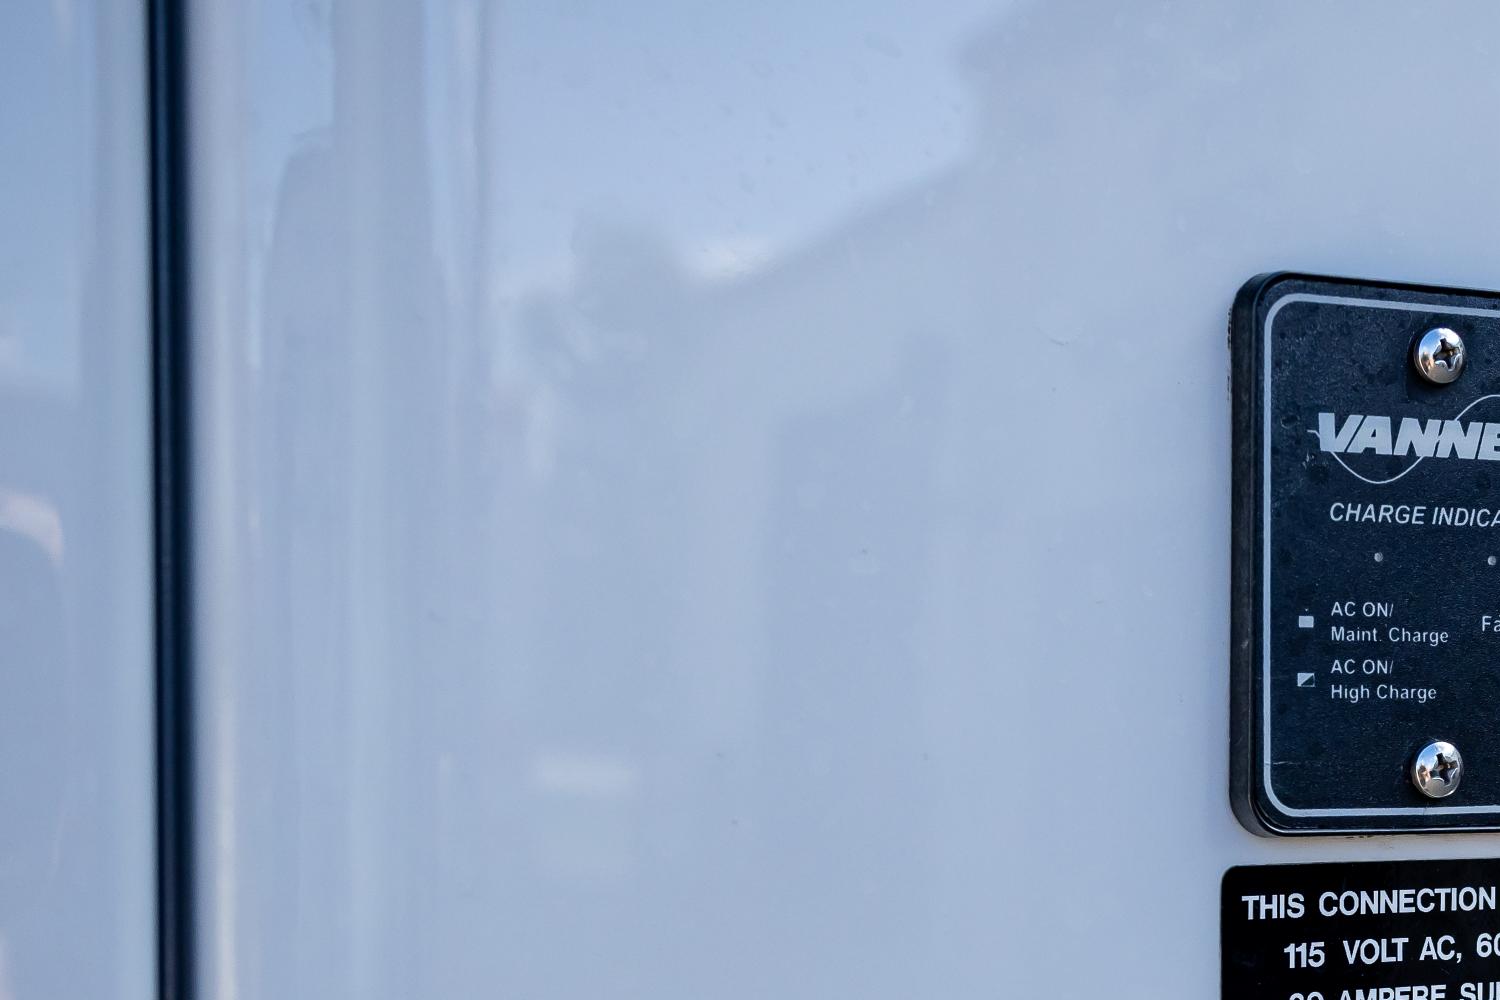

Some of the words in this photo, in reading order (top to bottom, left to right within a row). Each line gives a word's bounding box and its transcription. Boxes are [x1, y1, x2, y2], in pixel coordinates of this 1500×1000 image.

[1329, 502, 1425, 525] CHARGE
[1330, 601, 1356, 617] AC
[1362, 601, 1394, 617] ON/
[1331, 626, 1382, 642] Maint.
[1388, 627, 1449, 647] Charge
[1330, 659, 1356, 675] AC
[1362, 659, 1394, 675] ON/
[1331, 684, 1370, 703] High
[1376, 684, 1437, 703] Charge
[1241, 893, 1305, 920] THIS
[1318, 886, 1496, 917] CONNECTION
[1284, 941, 1325, 969] 115
[1342, 937, 1409, 965] VOLT
[1419, 936, 1463, 963] AC,
